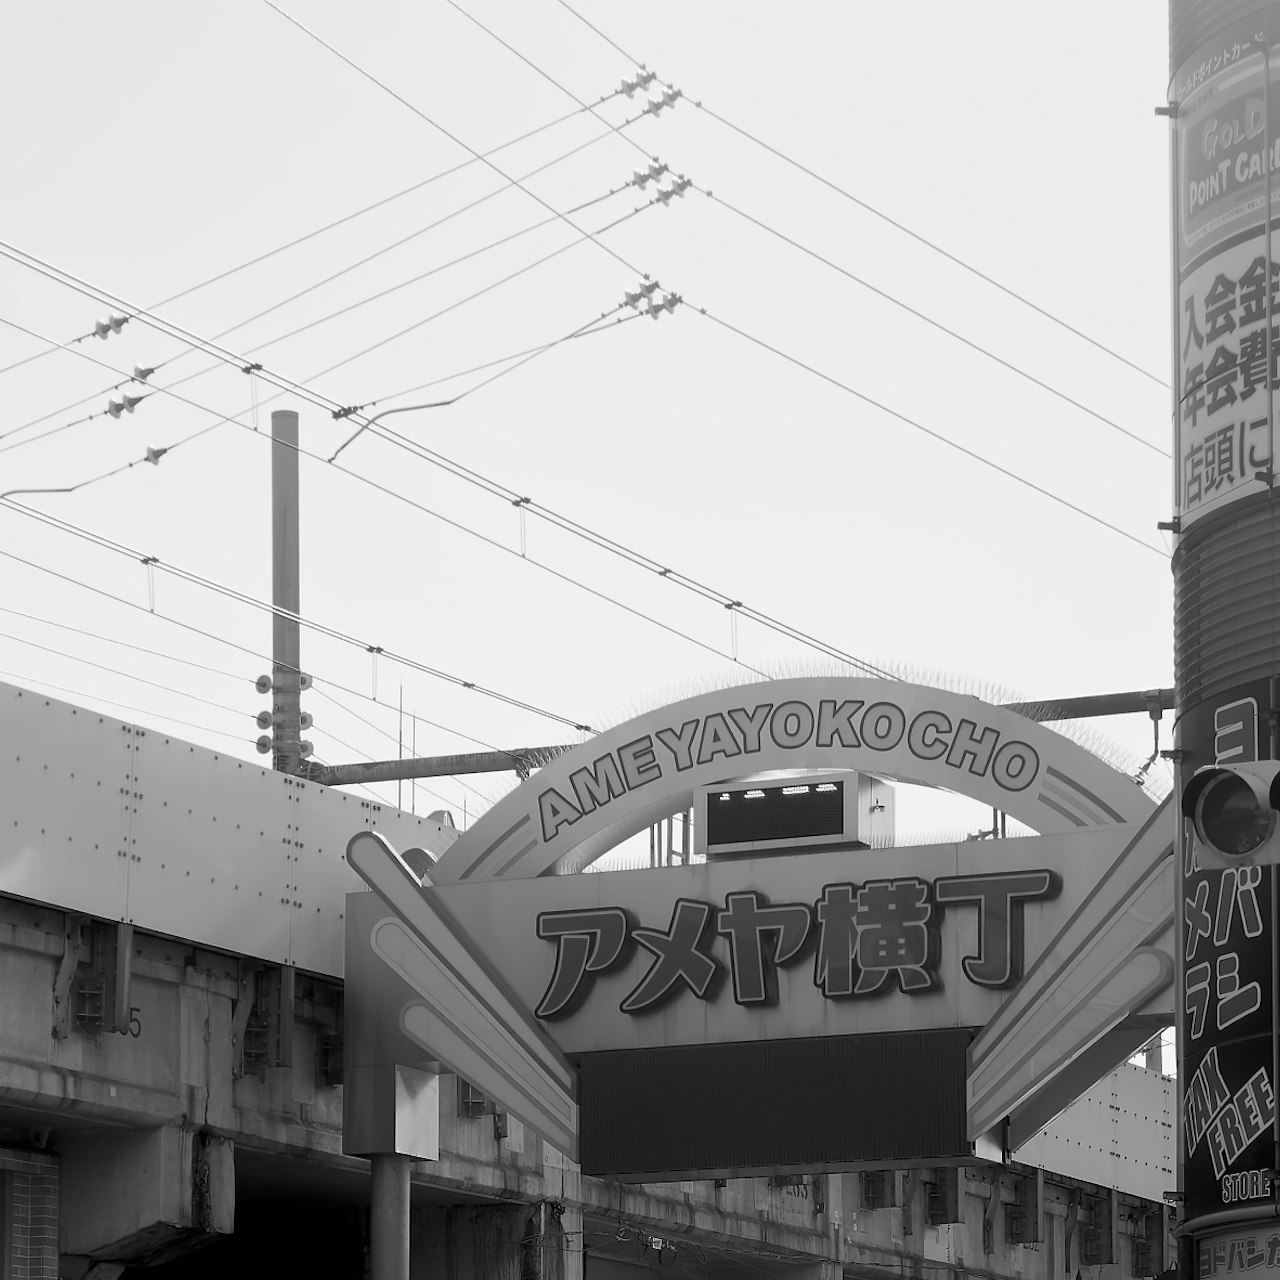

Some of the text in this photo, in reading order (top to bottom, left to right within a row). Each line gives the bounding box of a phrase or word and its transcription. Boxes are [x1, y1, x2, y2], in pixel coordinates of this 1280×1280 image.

[1189, 157, 1232, 214] POINT
[536, 698, 1043, 843] AMEYAYOKOCHO
[533, 868, 1063, 1021] アメヤ横丁
[1184, 1045, 1231, 1159] TAX
[1207, 1066, 1275, 1182] FREE
[1221, 1167, 1271, 1203] STORE
